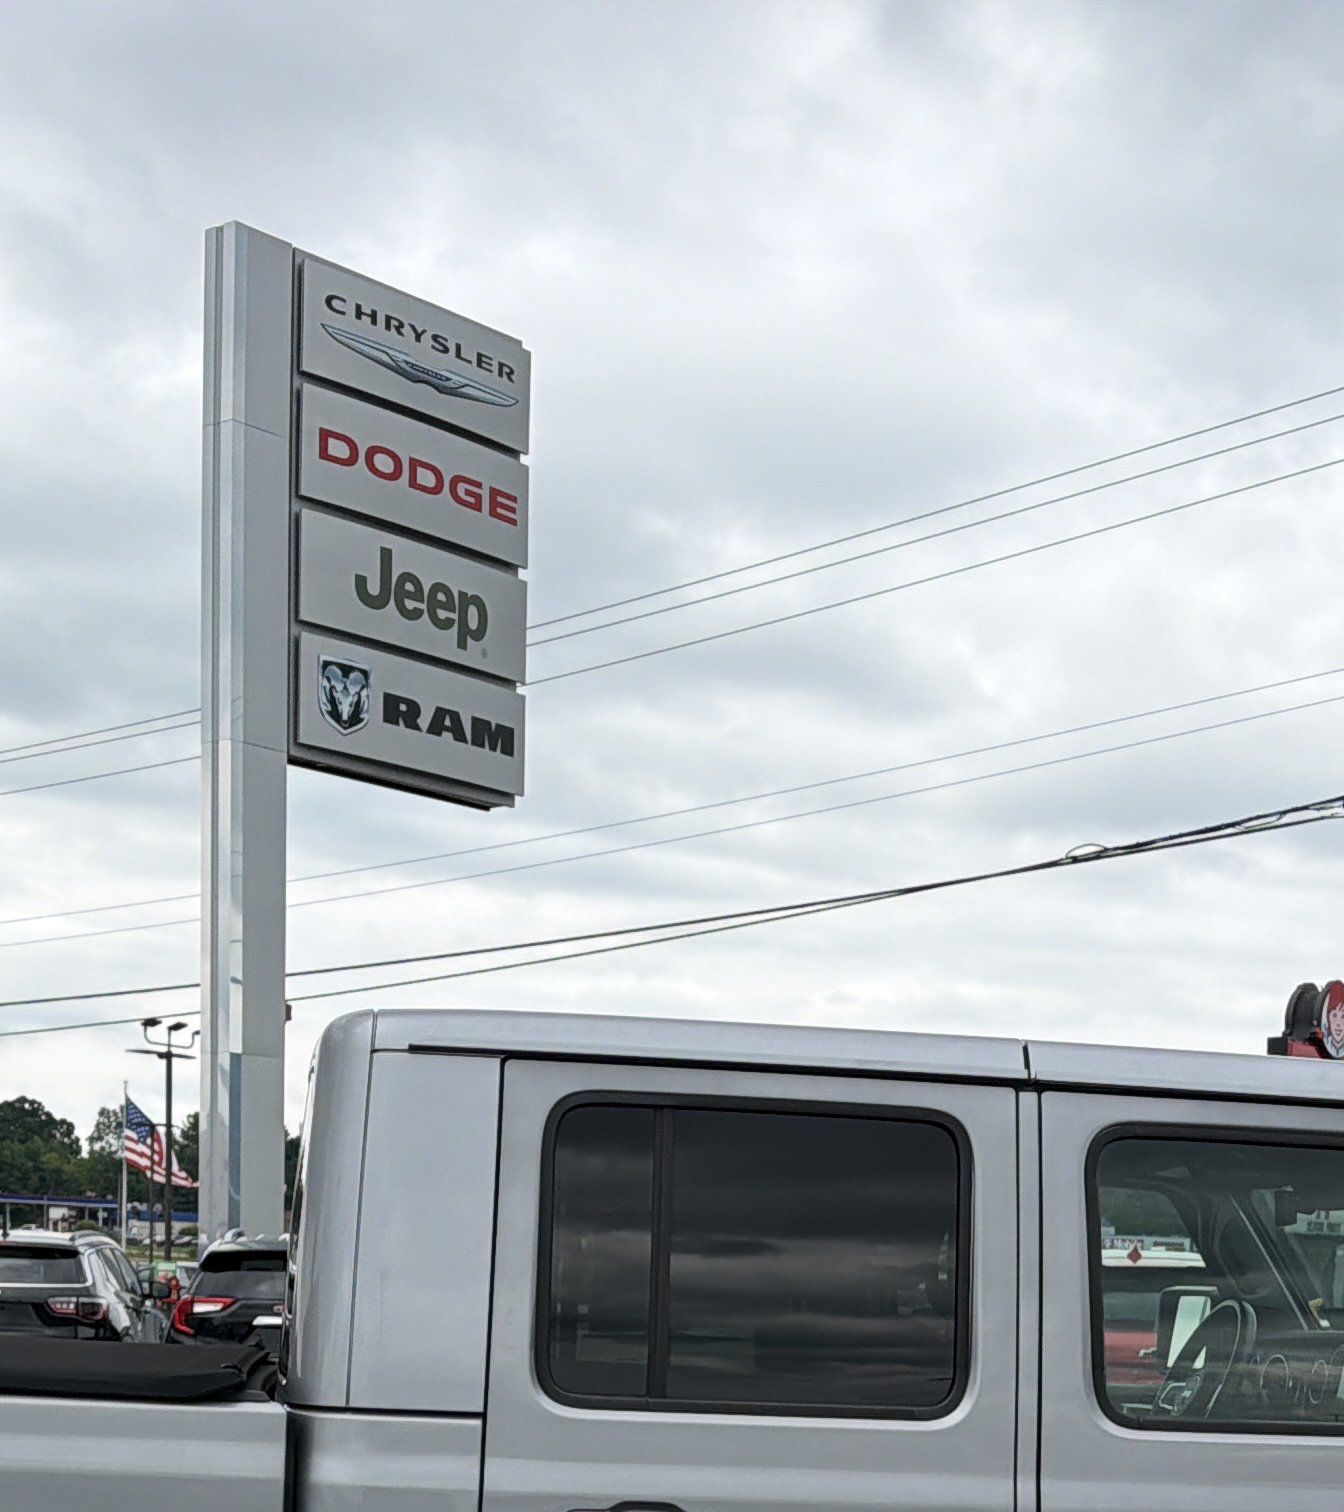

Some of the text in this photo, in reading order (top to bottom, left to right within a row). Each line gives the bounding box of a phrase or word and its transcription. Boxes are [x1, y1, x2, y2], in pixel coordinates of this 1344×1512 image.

[324, 294, 516, 384] CHRYSLER
[319, 427, 518, 526] DODGE
[354, 546, 488, 651] Jeep
[383, 691, 515, 757] RAM
